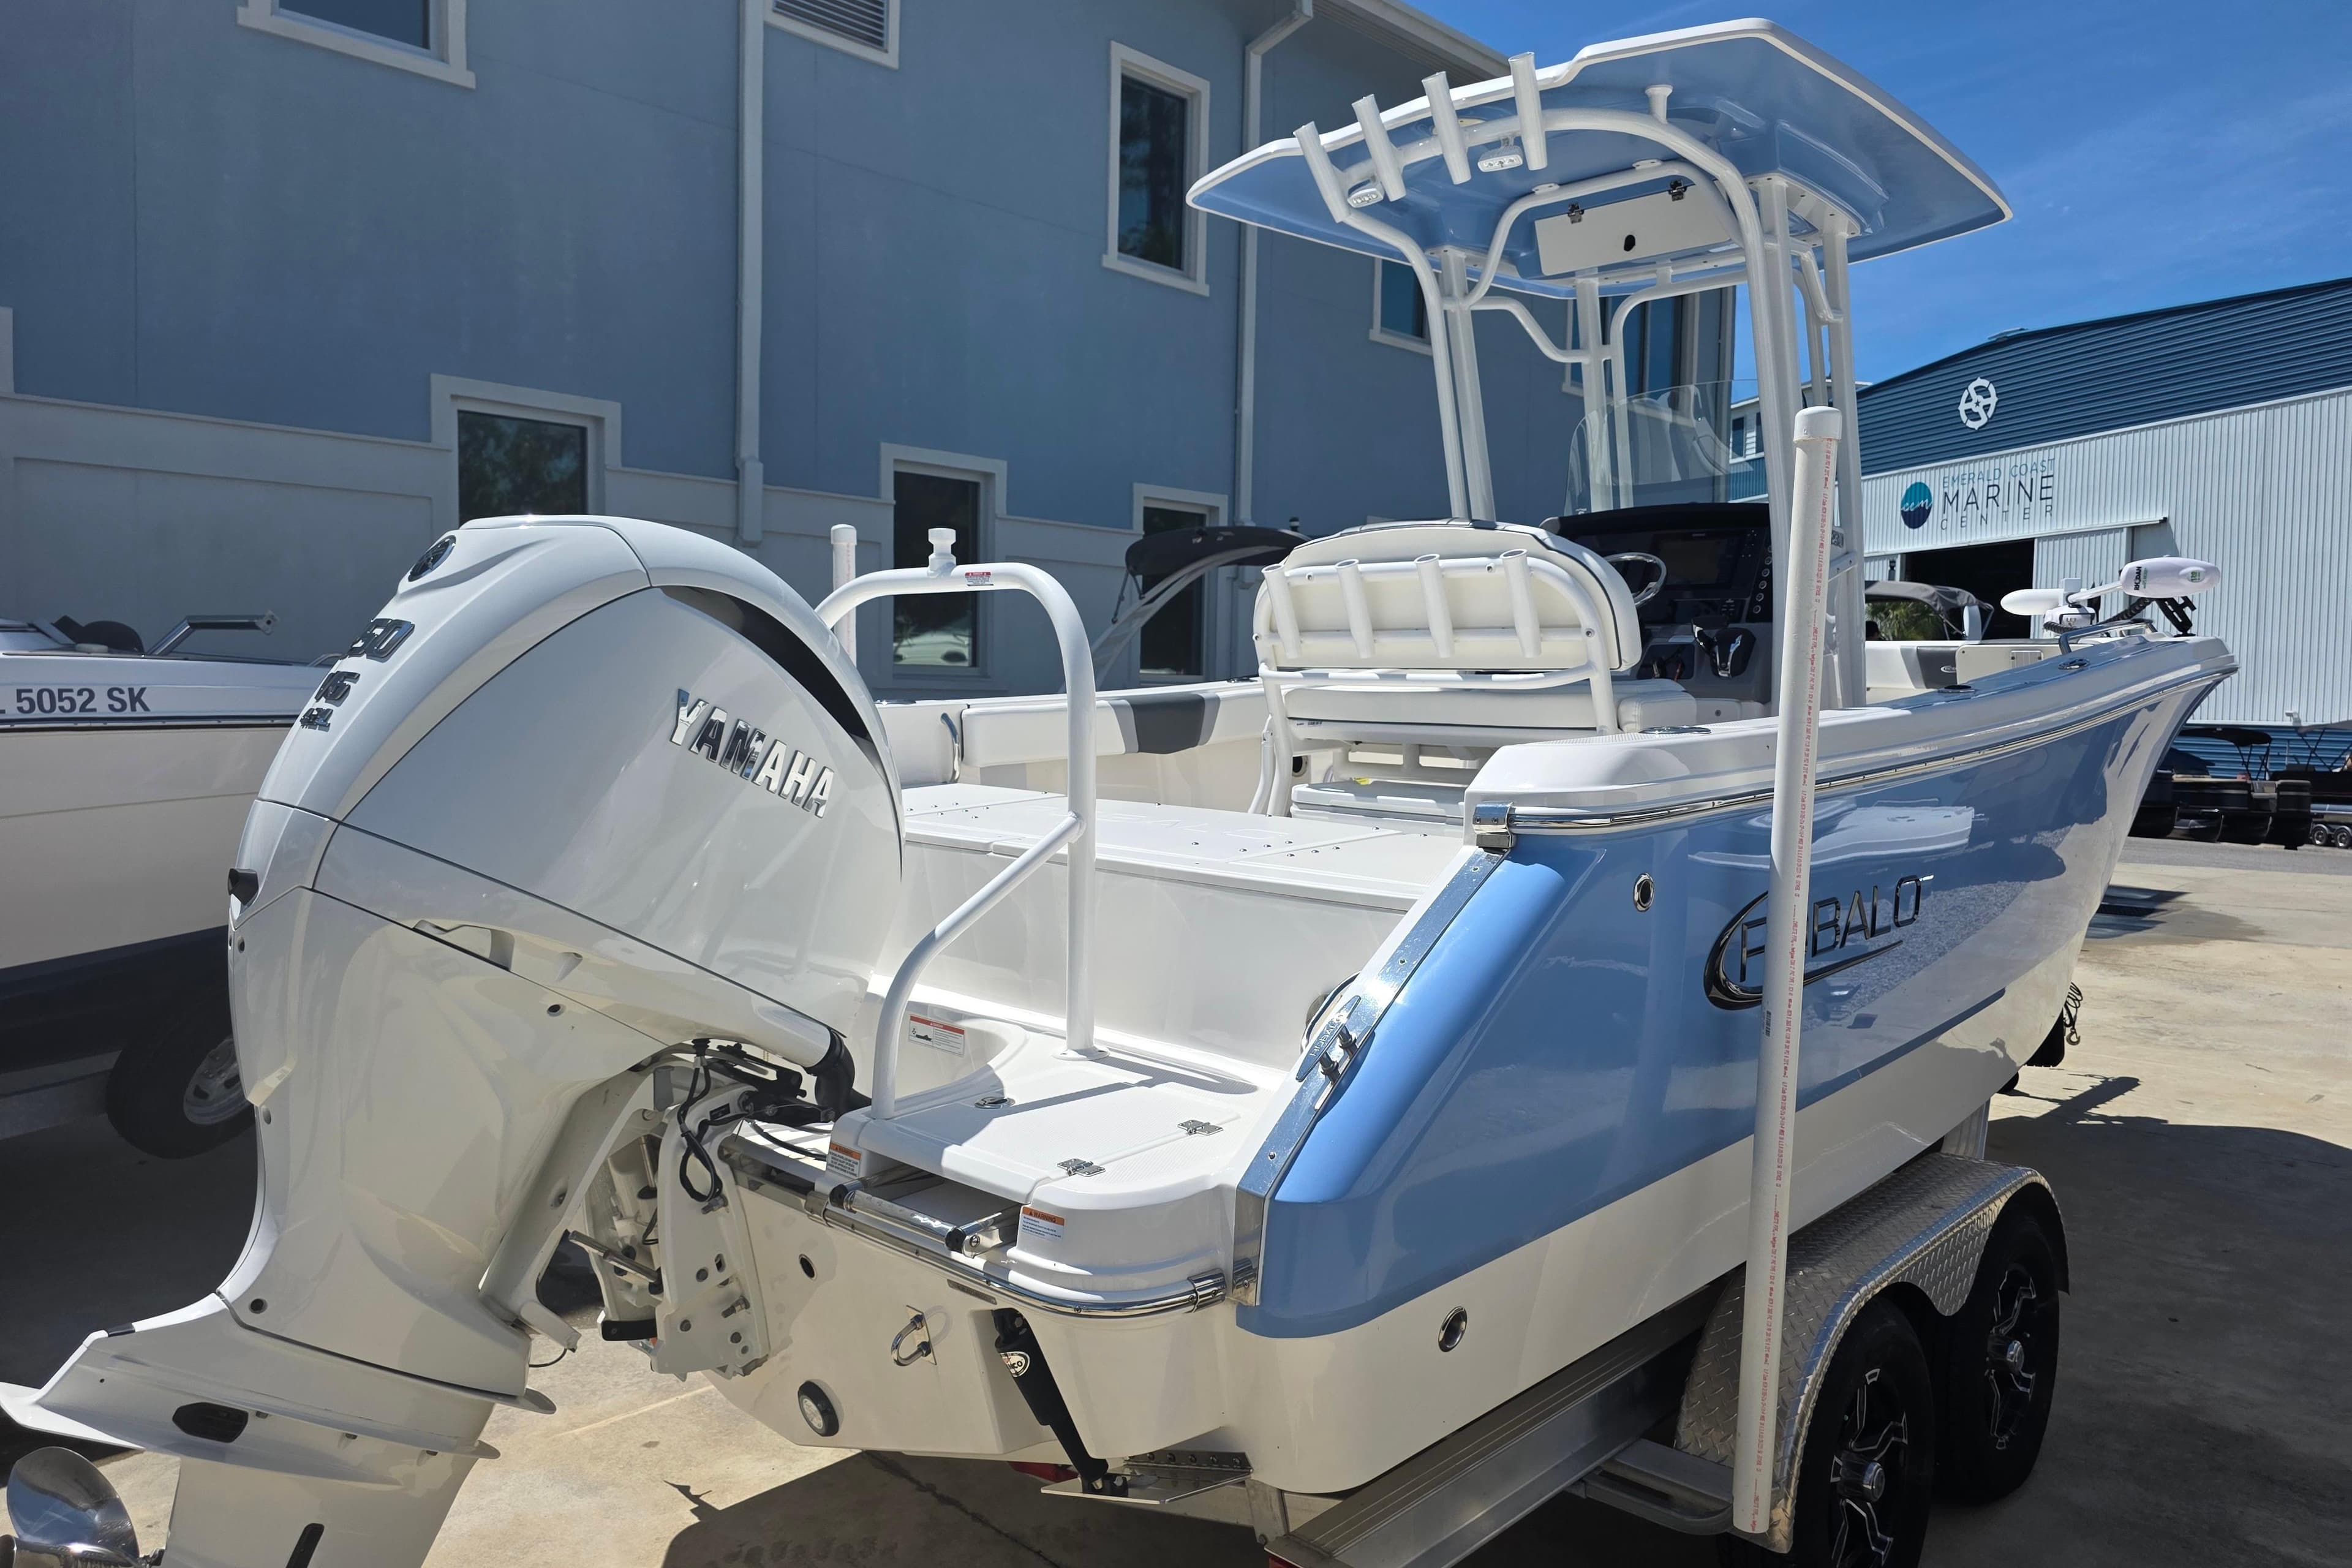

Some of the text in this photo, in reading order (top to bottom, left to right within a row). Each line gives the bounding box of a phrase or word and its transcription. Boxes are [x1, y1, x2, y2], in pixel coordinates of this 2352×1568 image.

[1942, 458, 2055, 489] EMERALD COAST
[1943, 474, 2054, 514] MARINE
[1940, 505, 2052, 530] CENTER
[15, 687, 151, 714] 5052 SK
[669, 688, 835, 820] YAMAHA
[1740, 875, 1922, 982] RBALO
[1033, 1210, 1057, 1224] WARNING
